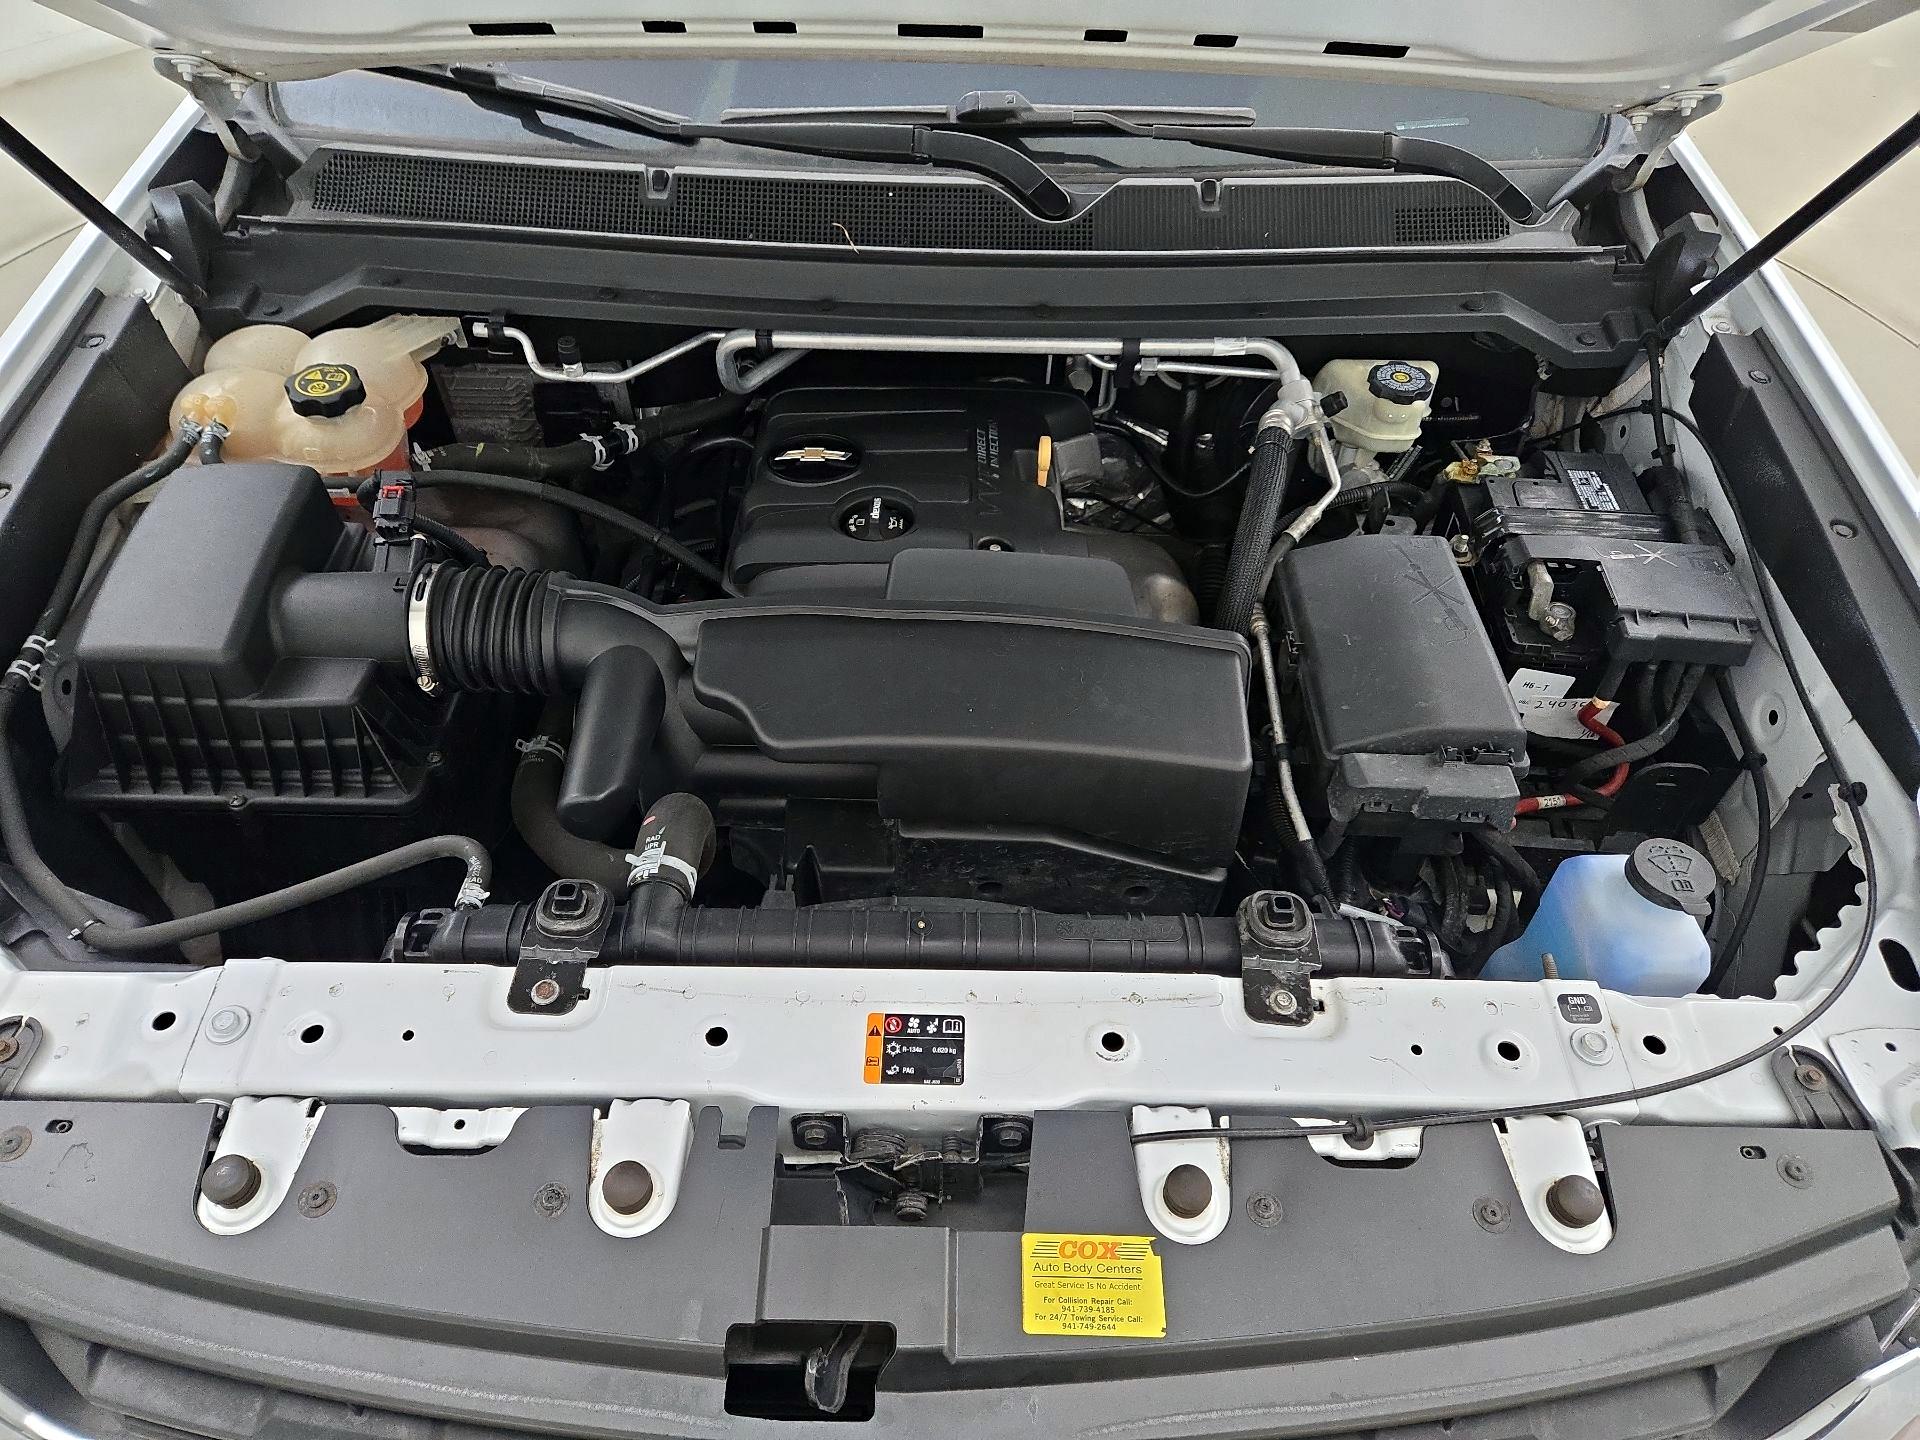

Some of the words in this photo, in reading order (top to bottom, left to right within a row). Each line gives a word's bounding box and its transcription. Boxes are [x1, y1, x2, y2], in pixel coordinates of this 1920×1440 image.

[645, 834, 661, 844] RAD
[1567, 996, 1587, 1005] GND
[1059, 1240, 1122, 1260] COX
[1033, 1262, 1060, 1272] Auto
[1063, 1262, 1093, 1275] Body
[1096, 1263, 1143, 1274] Centers
[1034, 1281, 1055, 1289] Great
[1057, 1281, 1085, 1289] Service
[1086, 1282, 1094, 1290] Is
[1096, 1282, 1107, 1290] No
[1109, 1282, 1142, 1291] Accident
[1043, 1296, 1056, 1304] For
[1058, 1296, 1088, 1305] Collision
[1091, 1297, 1115, 1306] Repair
[1116, 1297, 1133, 1306] Call:
[1061, 1304, 1116, 1314] 941-739-4185
[1034, 1312, 1047, 1321] For
[1049, 1313, 1068, 1322] 24/7
[1071, 1313, 1096, 1324] Towing
[1098, 1314, 1125, 1323] Service
[1127, 1315, 1144, 1323] Call:
[1061, 1322, 1117, 1331] 941-749-2644
